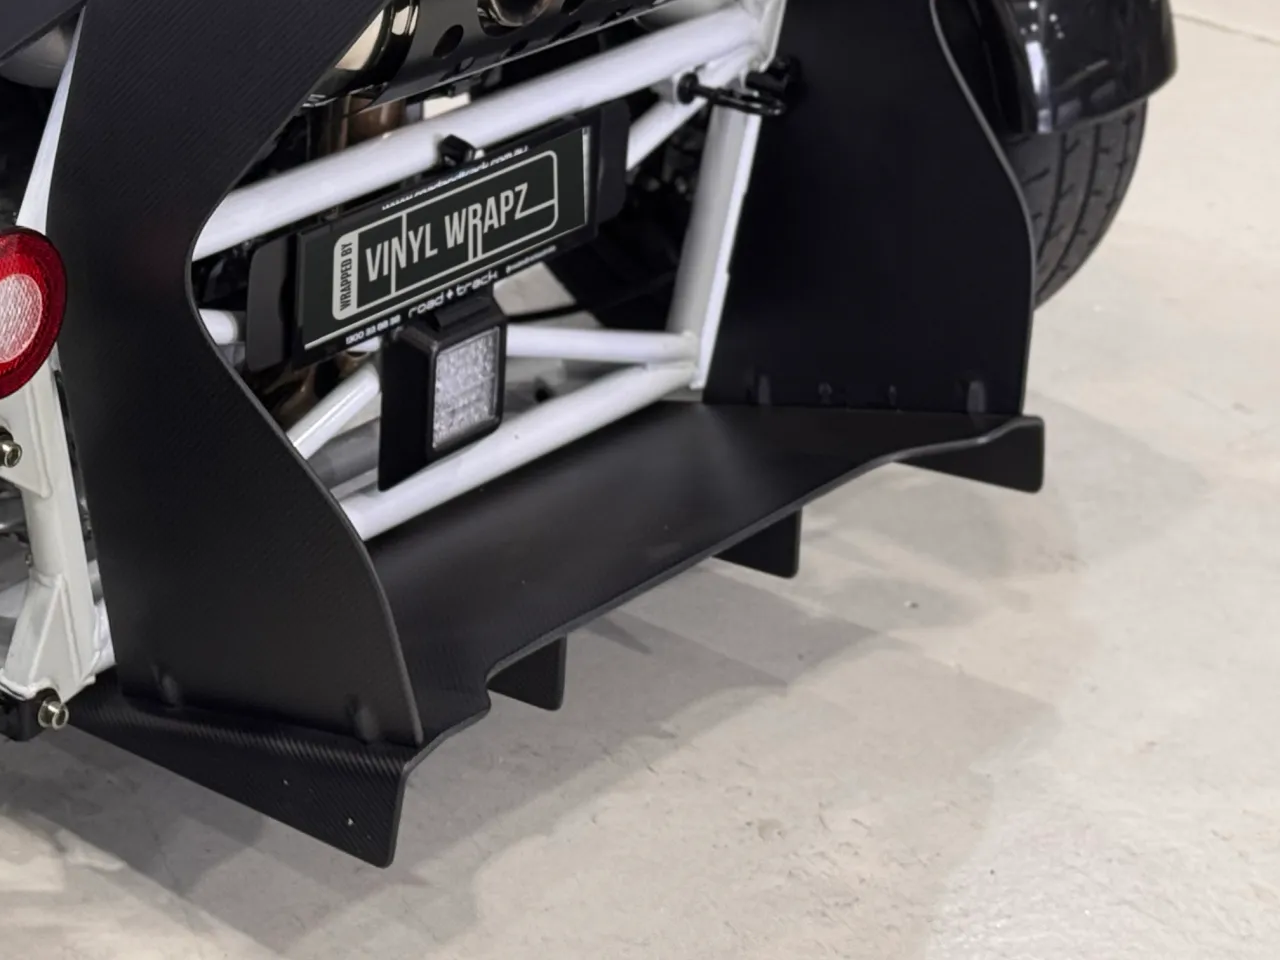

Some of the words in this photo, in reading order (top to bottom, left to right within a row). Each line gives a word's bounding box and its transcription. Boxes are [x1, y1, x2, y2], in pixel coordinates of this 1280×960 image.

[340, 242, 353, 257] BY
[365, 221, 439, 283] VINYL
[444, 182, 528, 250] WRAPZ
[339, 260, 353, 311] WRAPPED
[407, 291, 445, 318] road
[455, 270, 499, 297] track
